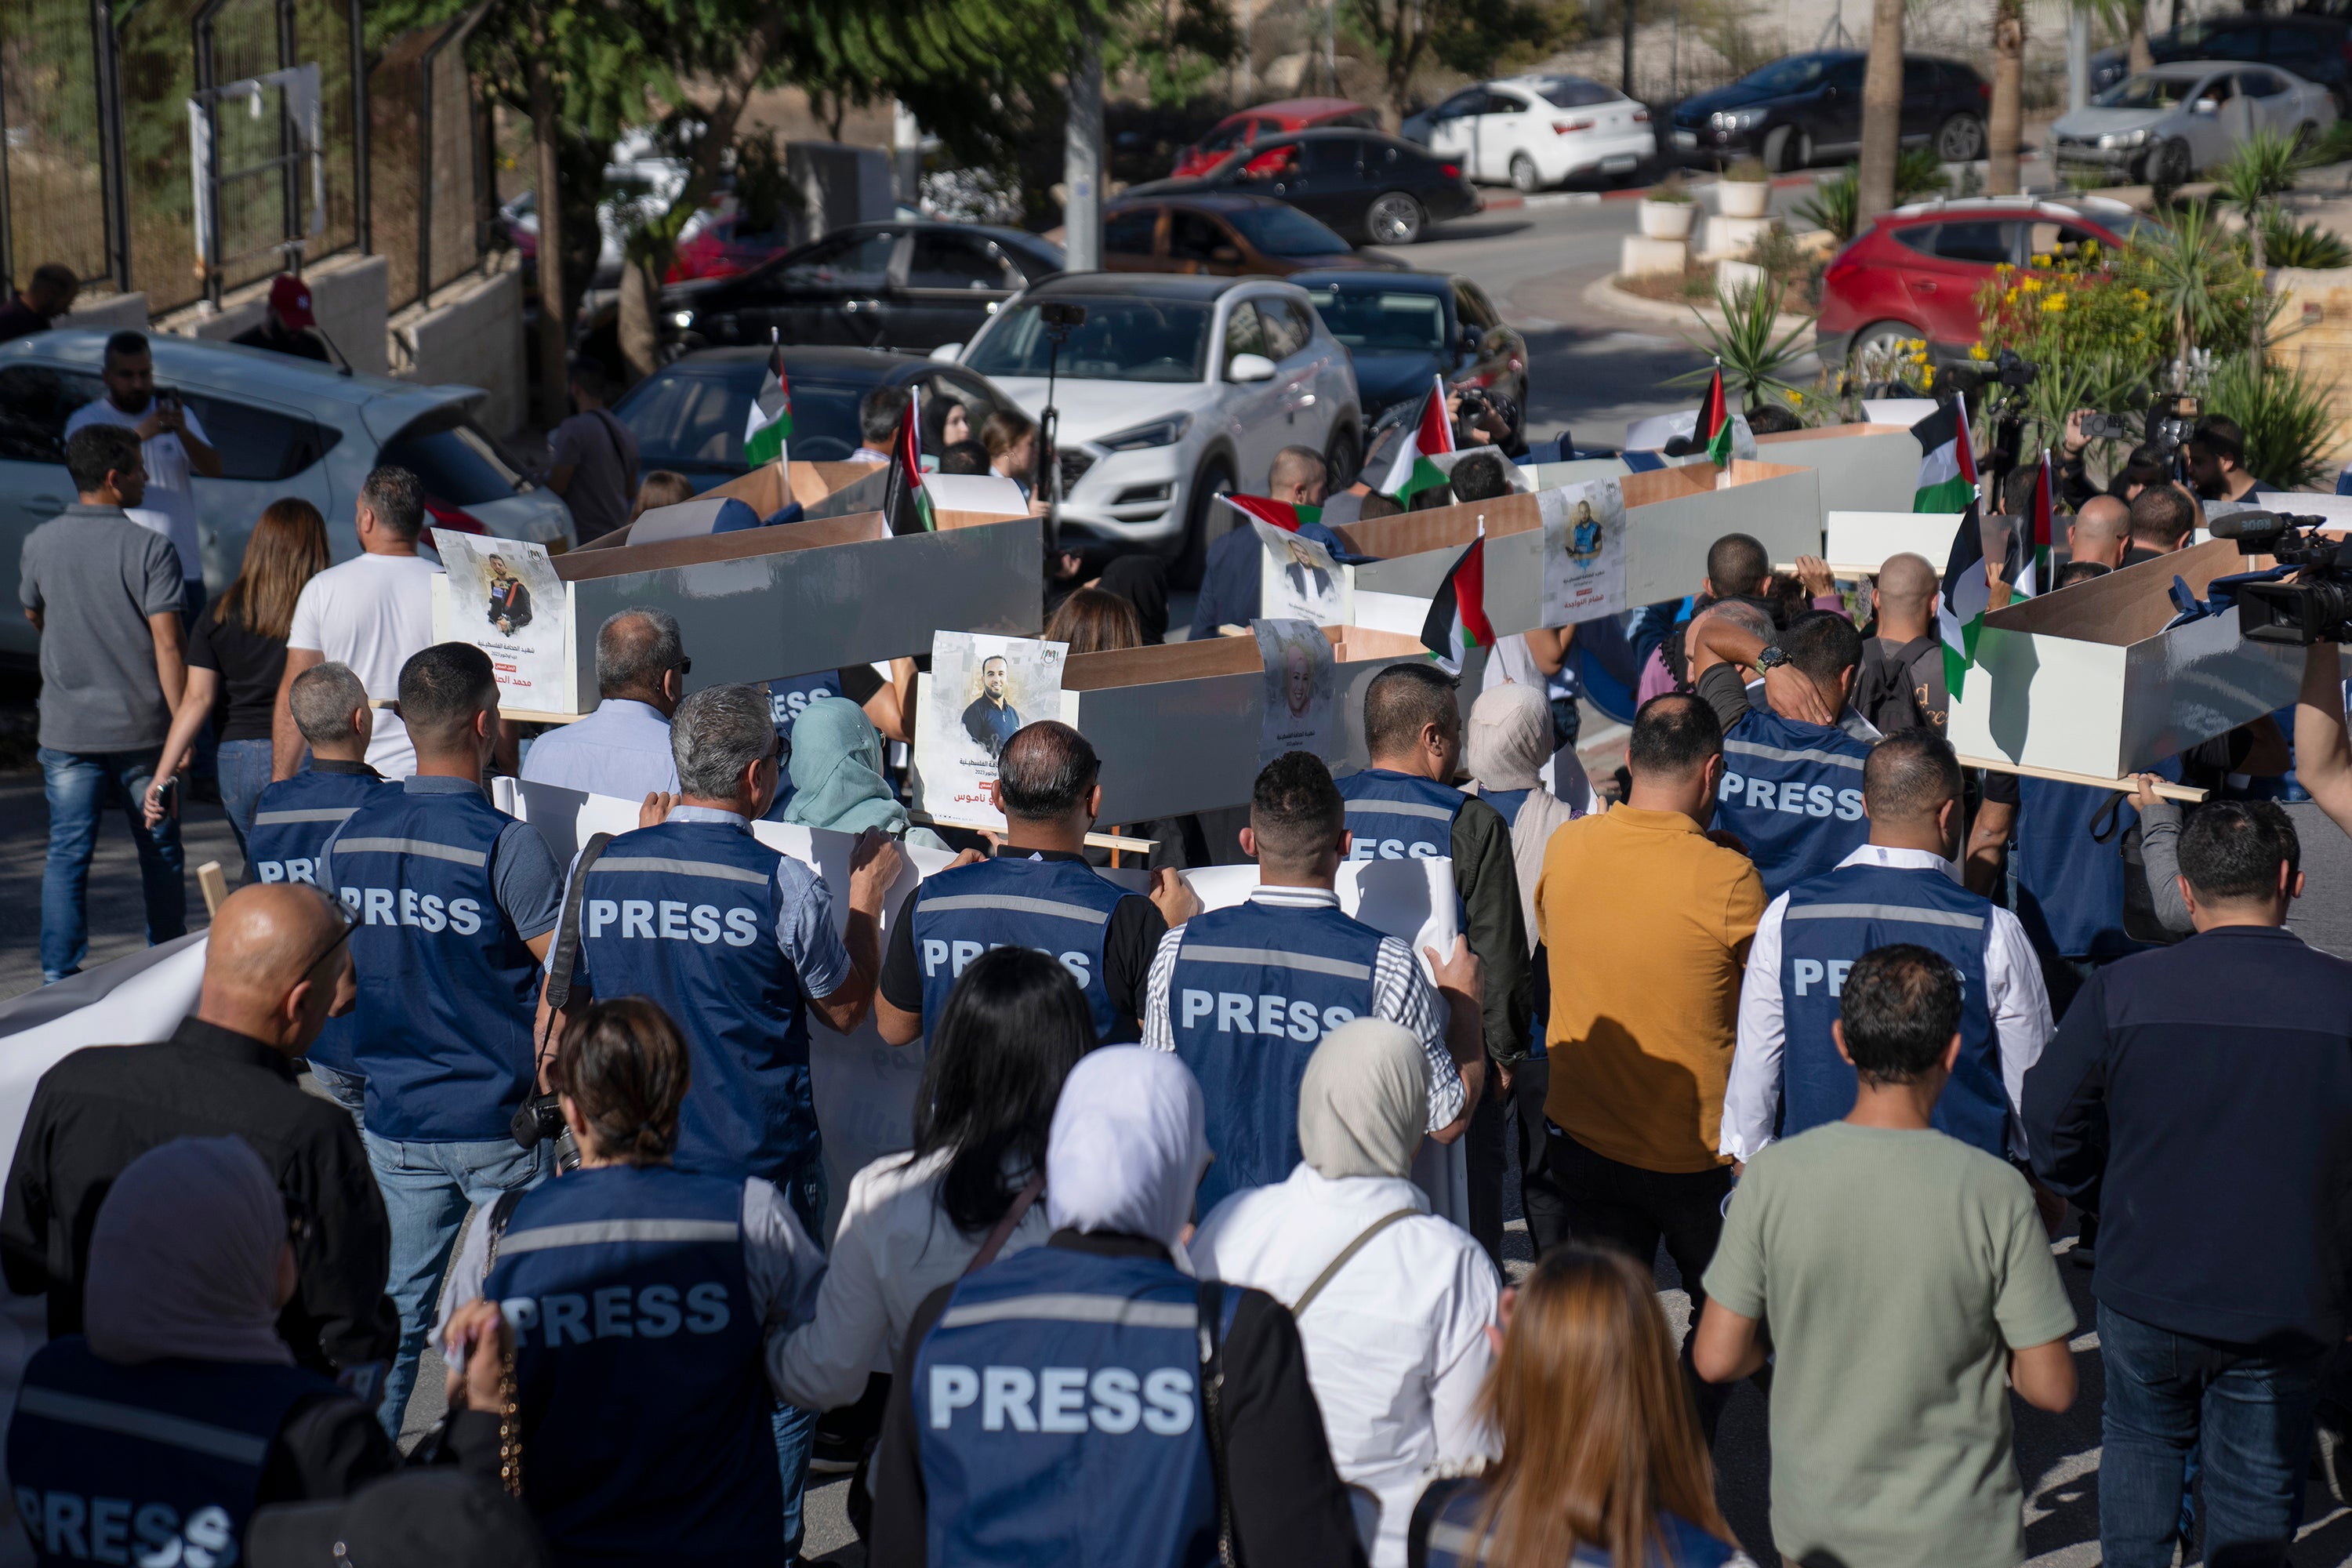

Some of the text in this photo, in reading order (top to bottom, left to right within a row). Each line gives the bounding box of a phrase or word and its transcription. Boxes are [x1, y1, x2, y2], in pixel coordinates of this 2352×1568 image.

[503, 643, 520, 652] الصحافة
[495, 674, 532, 687] محمد الصا
[960, 758, 988, 767] الفلسطينية
[954, 793, 985, 803] ناموس
[1719, 771, 1864, 821] PRESS
[1349, 837, 1438, 862] ESS
[340, 887, 481, 935] PRESS
[590, 899, 757, 947] PRESS
[923, 939, 1091, 989] PRS
[501, 1282, 730, 1348] PRESS
[929, 1365, 1195, 1435] PRESS
[16, 1484, 239, 1568] PRESS
